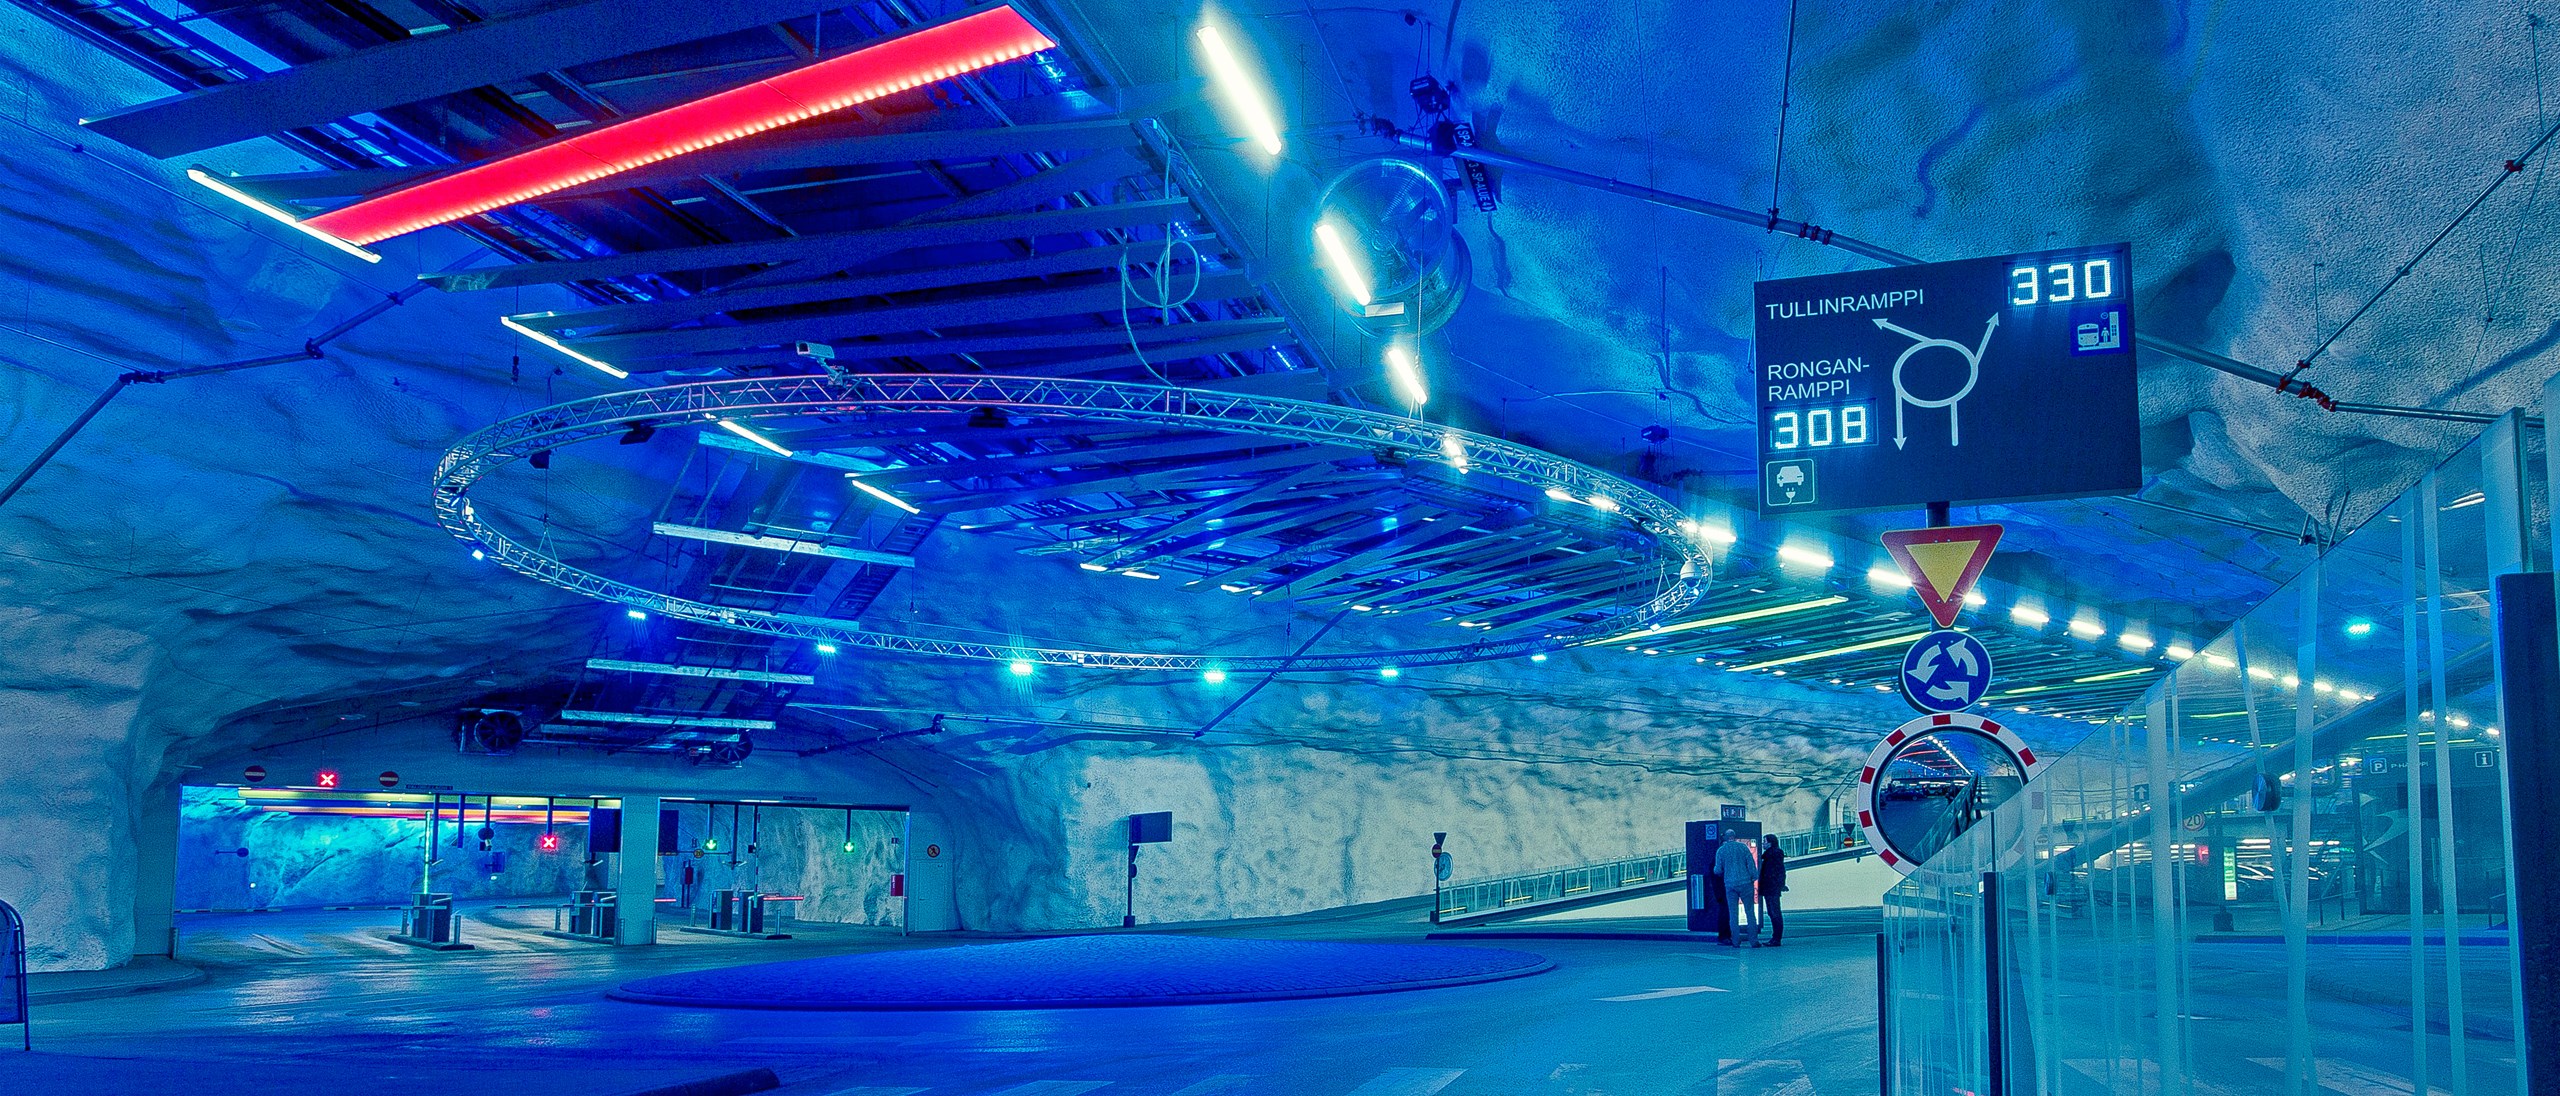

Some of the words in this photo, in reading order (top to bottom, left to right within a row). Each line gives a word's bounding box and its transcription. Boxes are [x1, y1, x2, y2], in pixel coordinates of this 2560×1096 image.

[2012, 259, 2111, 305] 330
[1766, 289, 1924, 320] TULLINRAMPPI
[1767, 357, 1870, 381] RONGAN-
[1768, 379, 1851, 402] RAMPPI
[1773, 406, 1866, 449] 308
[2186, 814, 2201, 826] 20
